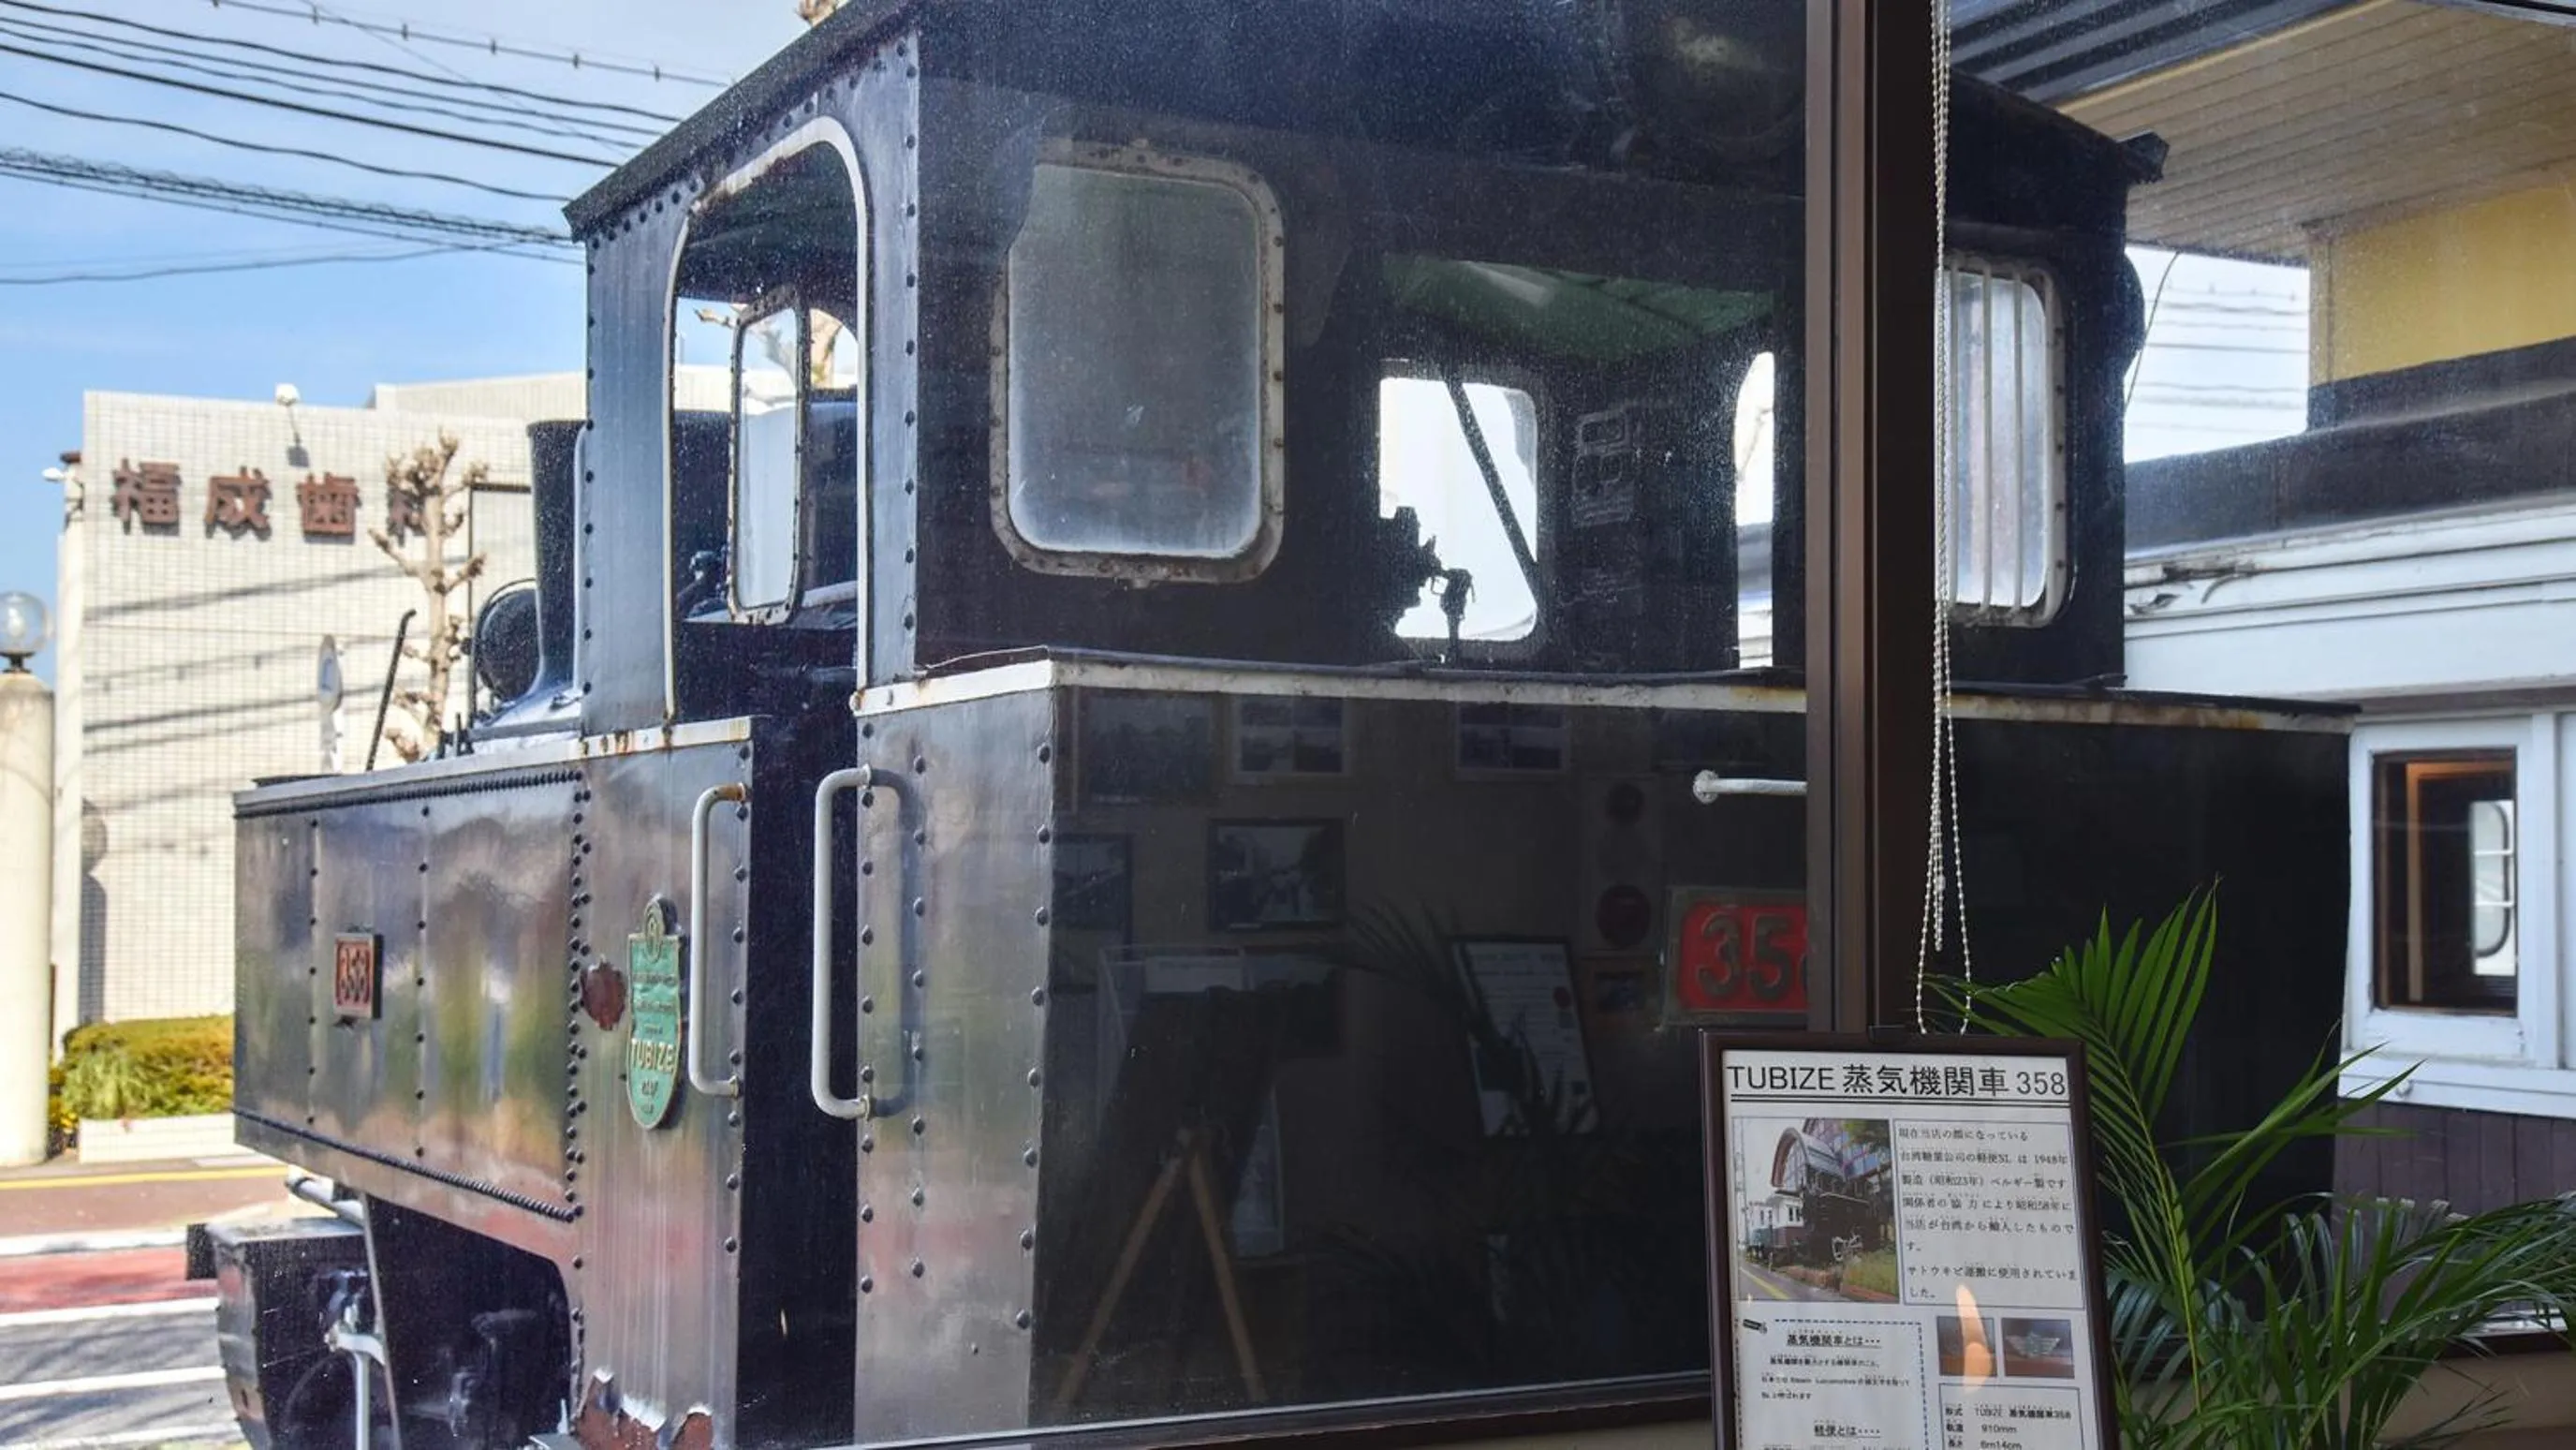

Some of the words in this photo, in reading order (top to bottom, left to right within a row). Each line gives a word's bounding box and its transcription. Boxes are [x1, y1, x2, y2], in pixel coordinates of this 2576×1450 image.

[1697, 910, 1807, 1002] 35
[631, 1038, 675, 1073] TUBIZE
[1727, 1066, 1835, 1091] TUBIZE
[1842, 1063, 2010, 1096] 蒸気機関車
[2016, 1071, 2066, 1096] 358
